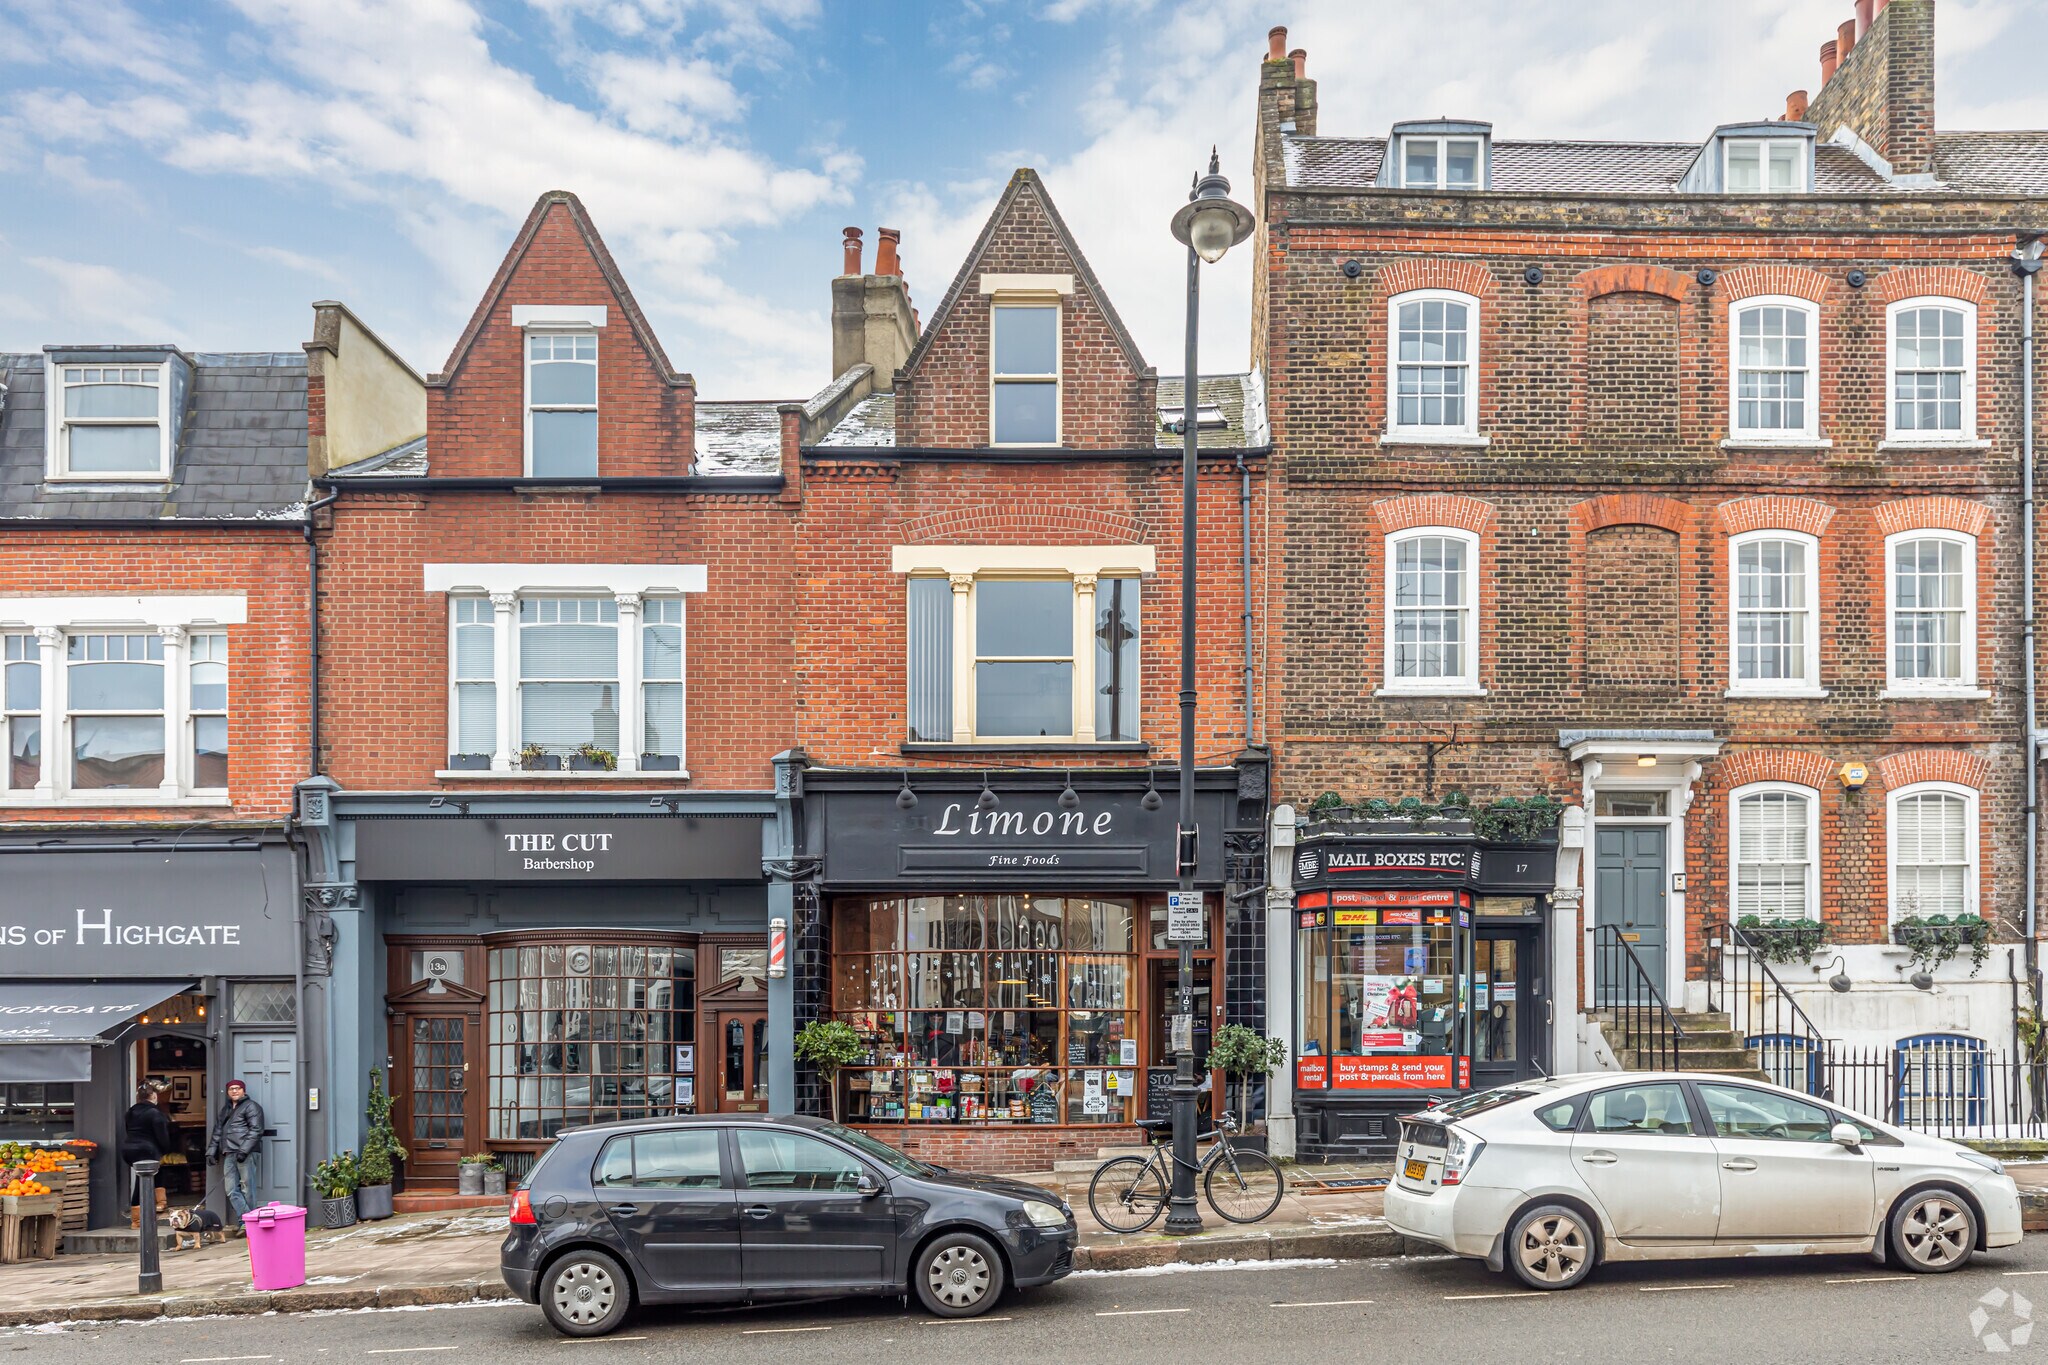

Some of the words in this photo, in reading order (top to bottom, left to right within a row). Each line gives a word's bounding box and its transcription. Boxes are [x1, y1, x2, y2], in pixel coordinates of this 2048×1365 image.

[932, 804, 1112, 836] Limone
[504, 834, 556, 852] THE
[562, 834, 612, 852] CUT
[524, 858, 594, 872] Barbershop
[988, 856, 1018, 866] Fine
[1022, 854, 1060, 866] Foods
[1328, 854, 1370, 866] MAIL
[1374, 853, 1426, 866] BOXES
[1516, 864, 1528, 872] 17
[1172, 897, 1178, 905] P
[1336, 894, 1358, 903] post,
[34, 929, 66, 946] OF
[76, 908, 240, 945] HIGHGATE
[430, 962, 446, 971] 13a
[1340, 1063, 1356, 1073] buy
[1359, 1064, 1388, 1072] stamps
[1340, 1074, 1358, 1082] post
[1372, 1073, 1400, 1082] parcels
[1203, 1144, 1219, 1162] GIANT
